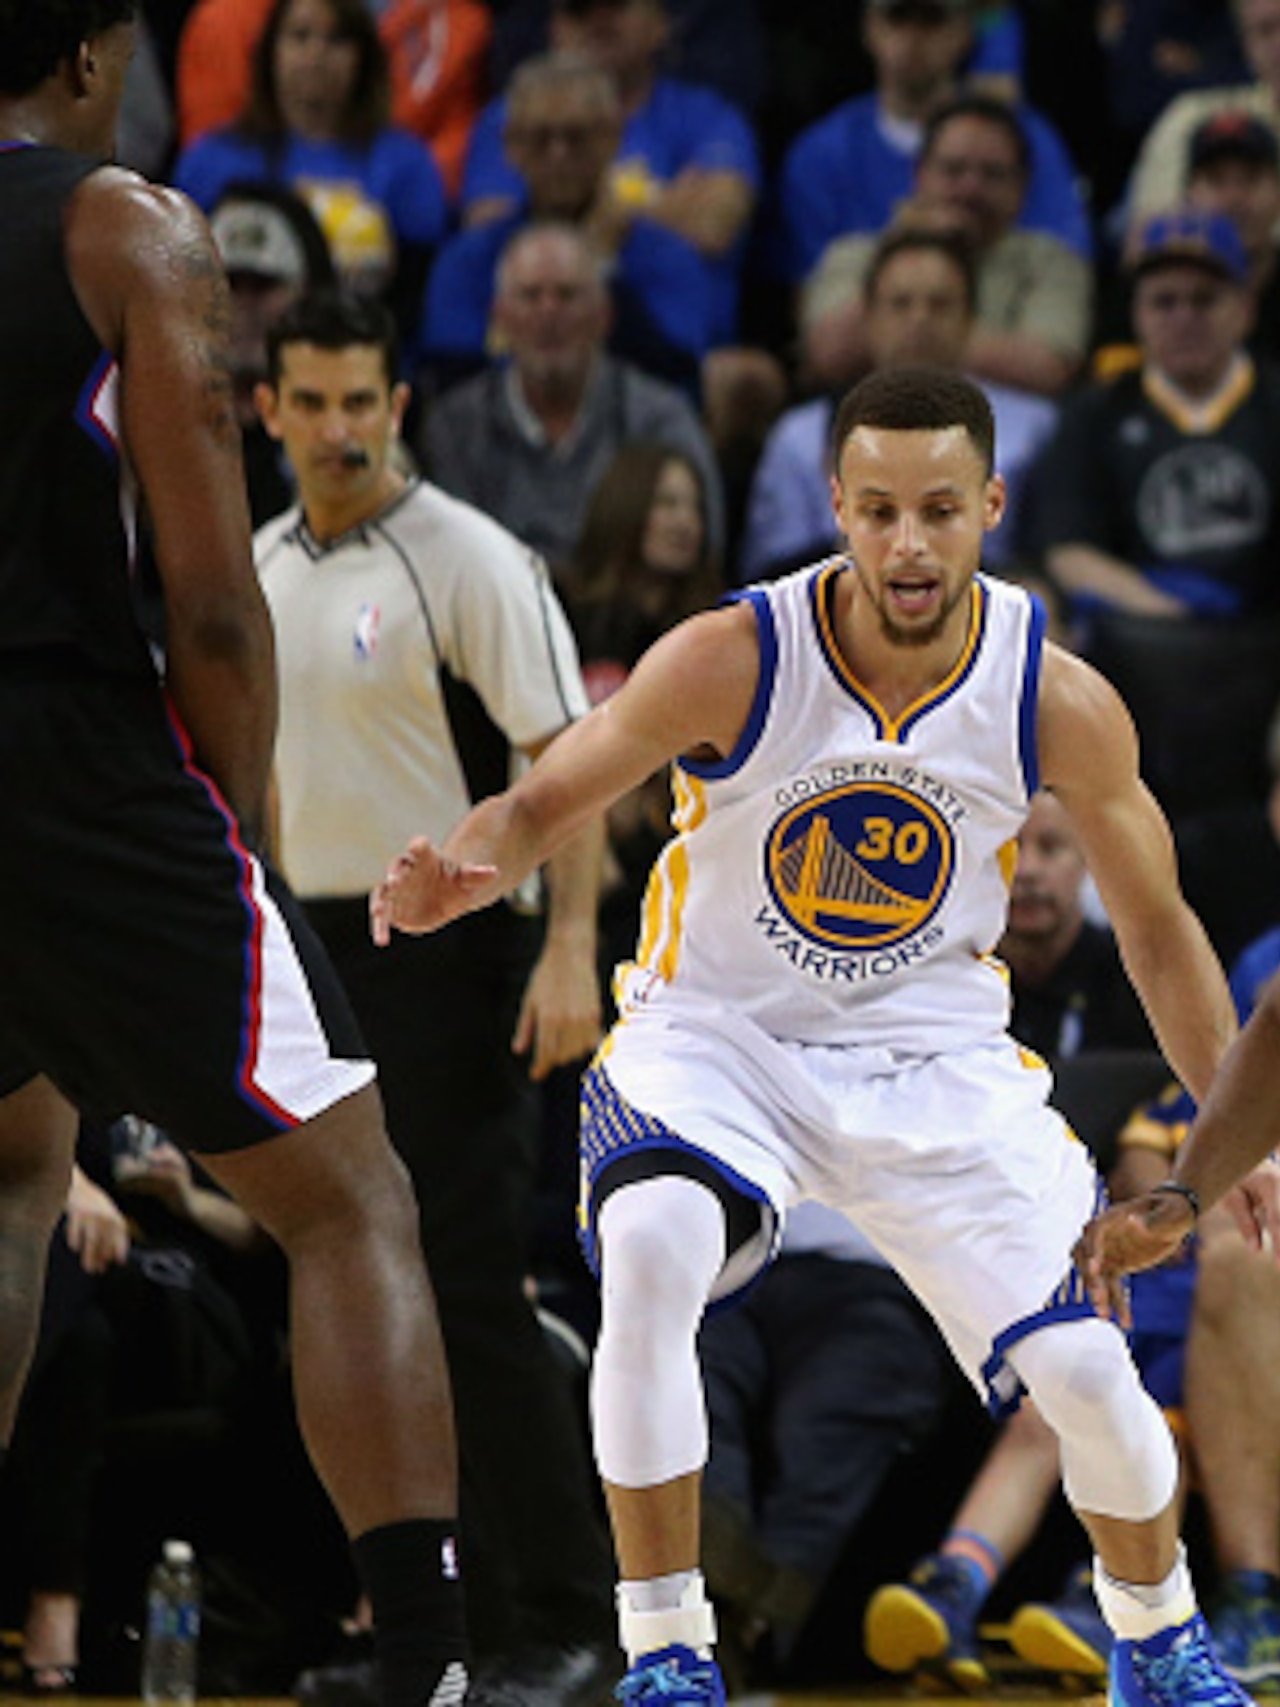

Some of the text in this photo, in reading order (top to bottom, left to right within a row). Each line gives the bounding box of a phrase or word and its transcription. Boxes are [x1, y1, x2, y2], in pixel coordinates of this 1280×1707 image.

[775, 762, 969, 822] GOLDEN STATE
[855, 815, 930, 865] 30
[755, 905, 944, 982] WARRIORS
